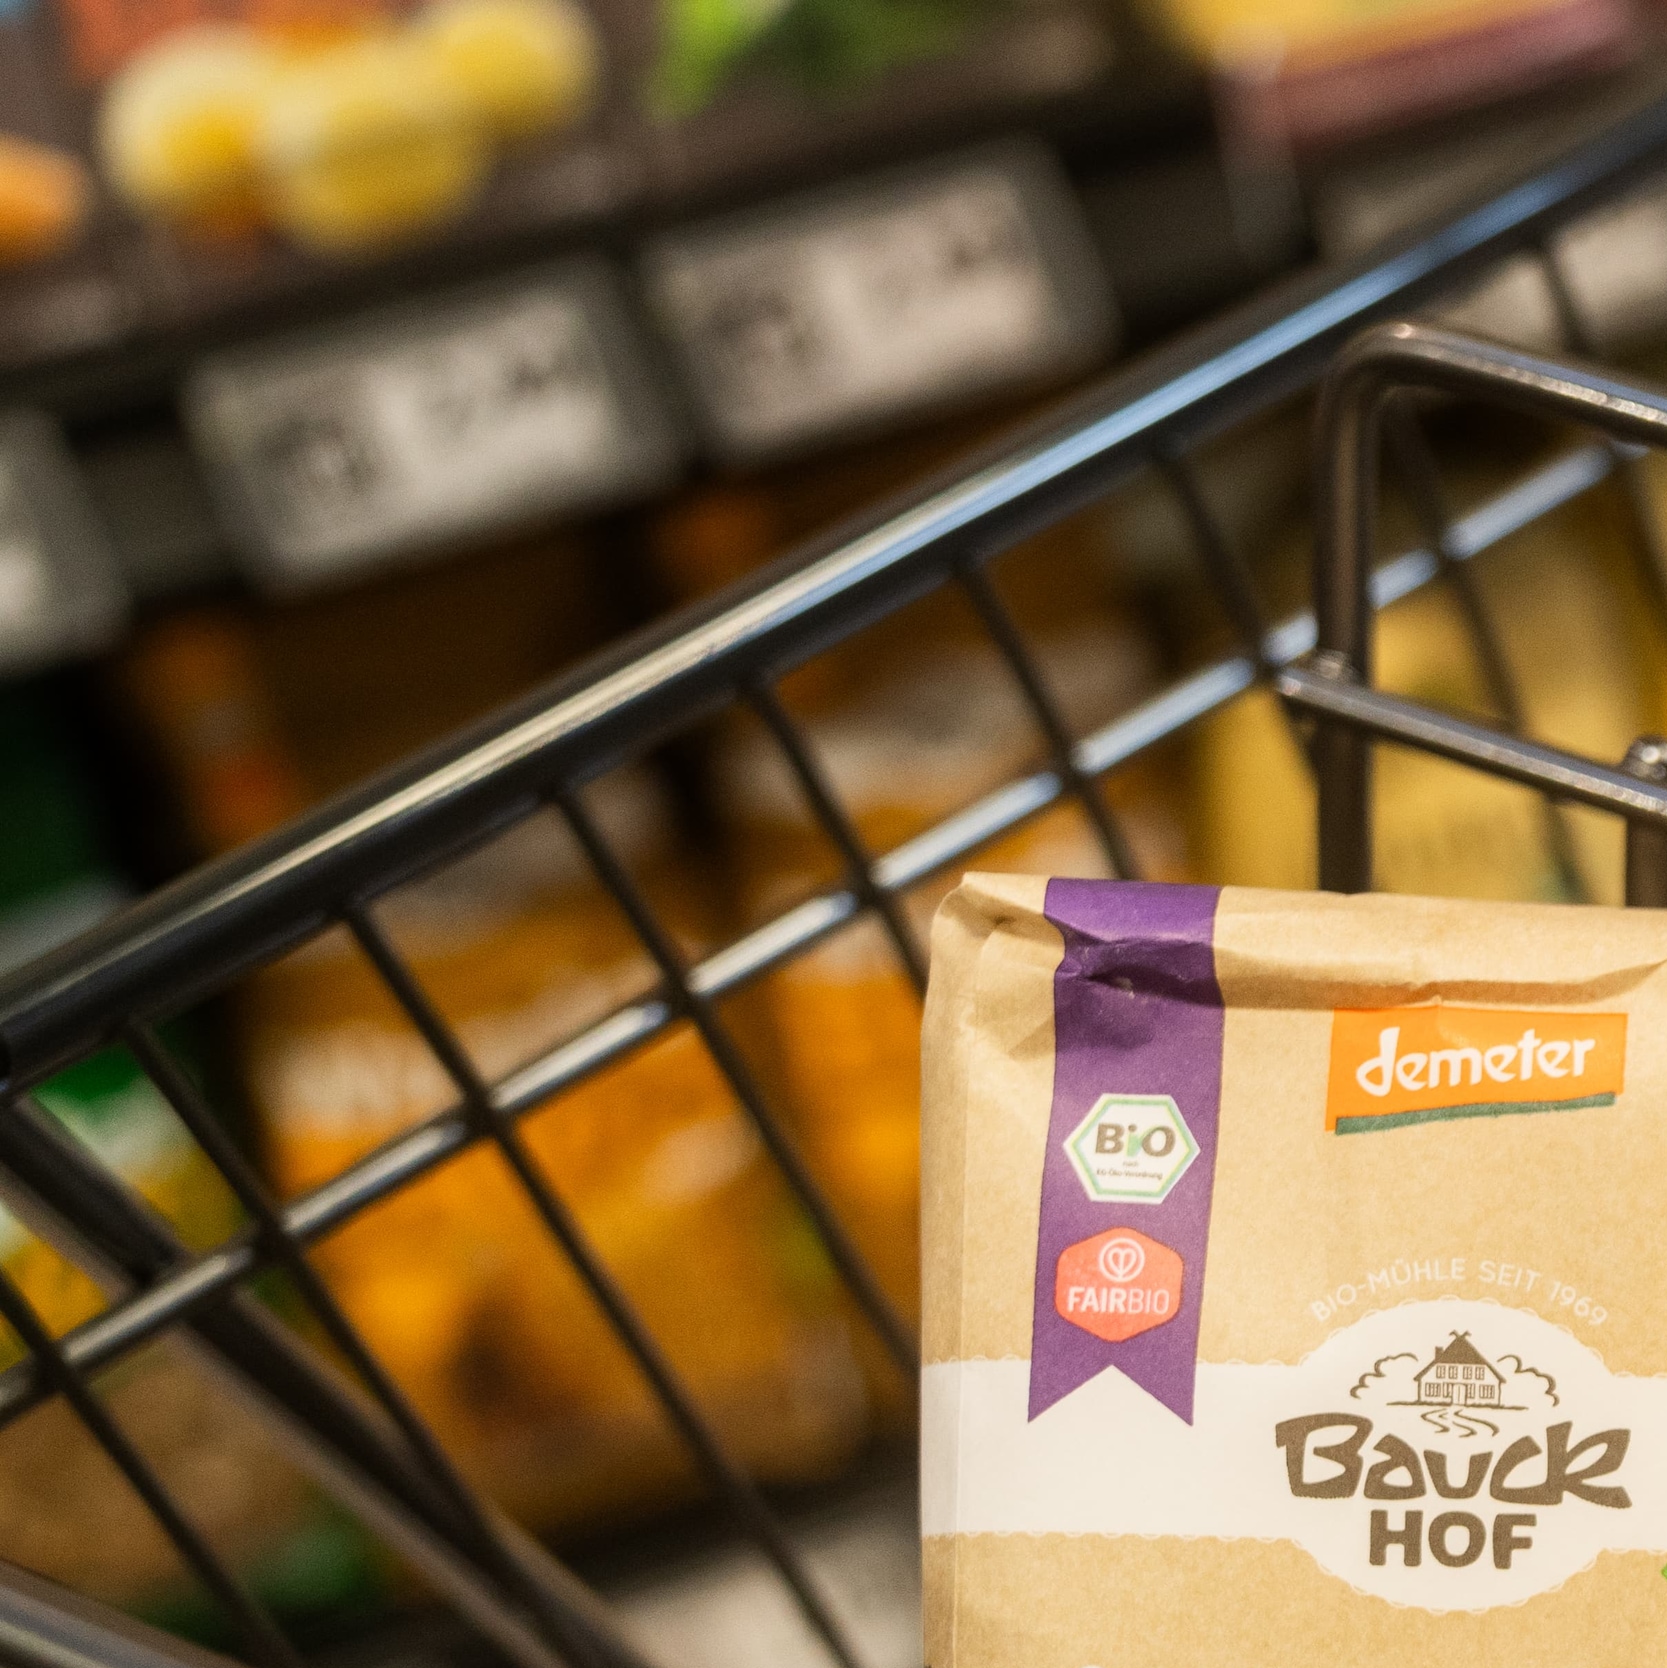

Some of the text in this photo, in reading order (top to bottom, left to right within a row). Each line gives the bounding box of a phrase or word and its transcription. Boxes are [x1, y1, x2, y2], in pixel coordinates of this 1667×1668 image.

[1356, 1026, 1596, 1097] demeter
[1067, 1286, 1171, 1315] FAIRBIO
[1310, 1257, 1608, 1327] BIO-MÜHLE SEIT 1969
[1369, 1509, 1537, 1570] HOF
